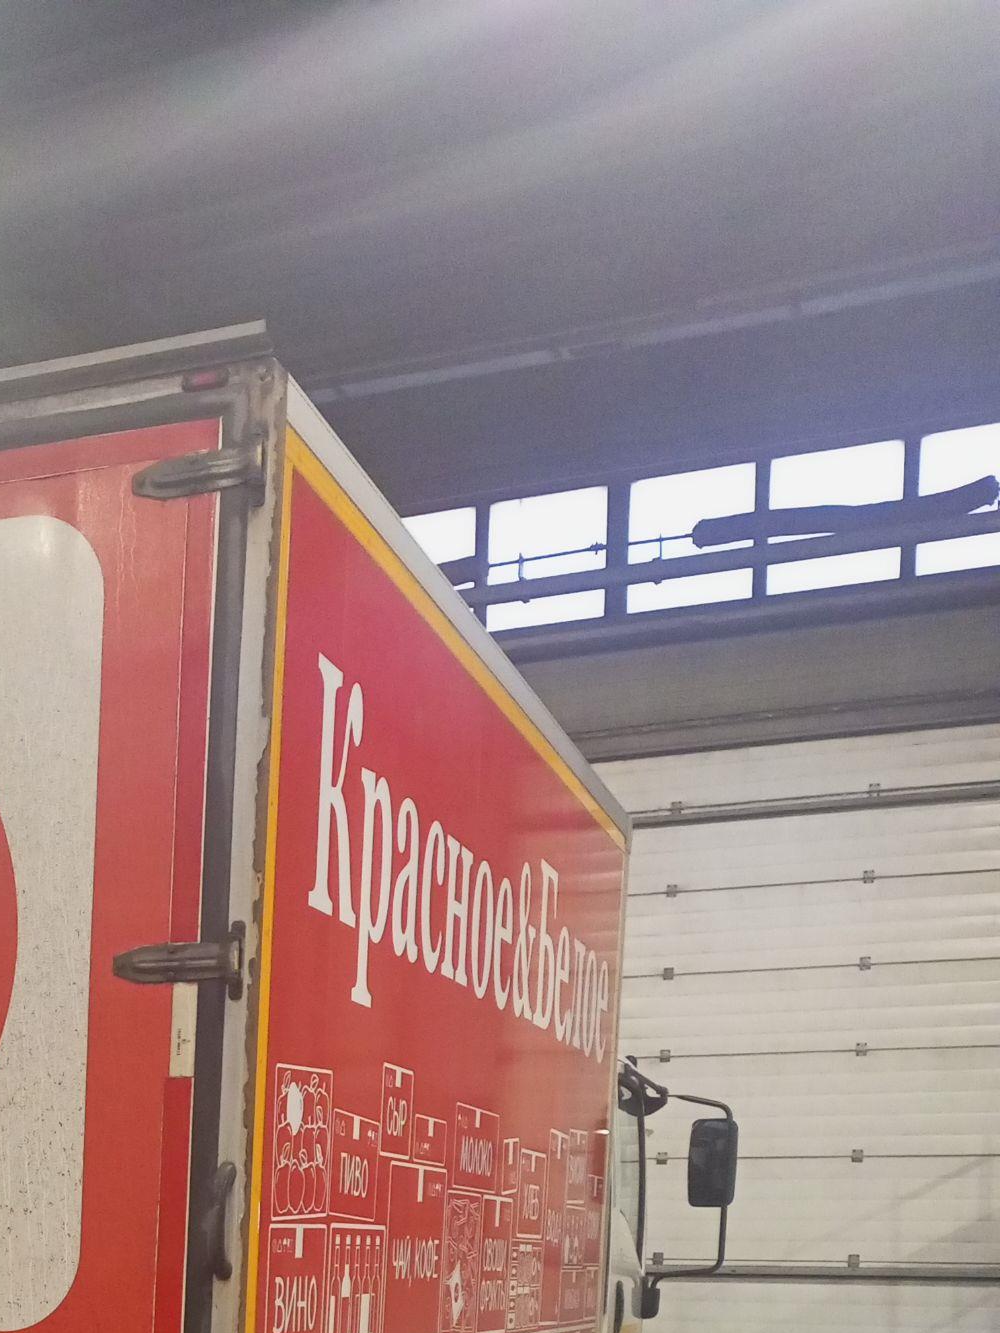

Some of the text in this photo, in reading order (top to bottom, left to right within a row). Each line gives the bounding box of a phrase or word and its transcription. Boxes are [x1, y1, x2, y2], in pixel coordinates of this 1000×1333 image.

[308, 652, 609, 1064] Красное&Белое
[386, 1096, 408, 1136] СЫР
[338, 1152, 369, 1198] ПИВО
[459, 1136, 493, 1177] МОЛОКО
[414, 1238, 440, 1281] КОФЕ
